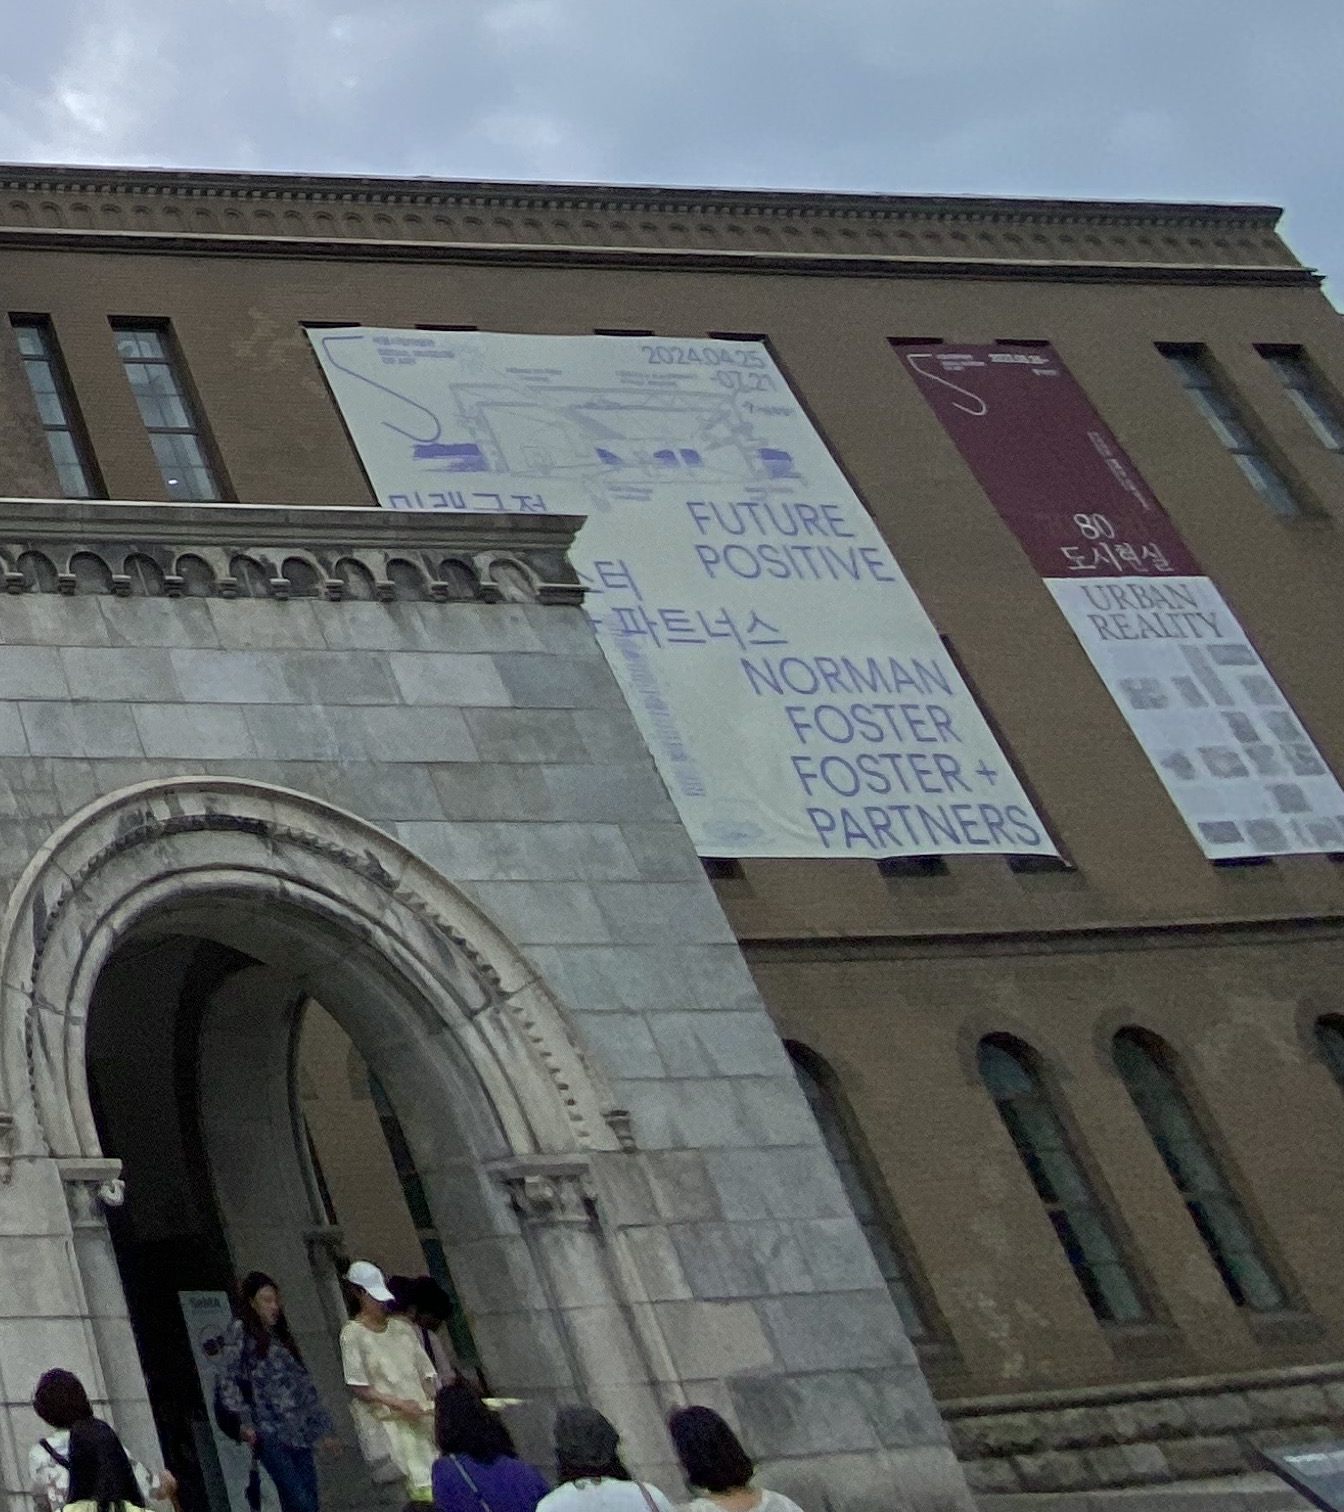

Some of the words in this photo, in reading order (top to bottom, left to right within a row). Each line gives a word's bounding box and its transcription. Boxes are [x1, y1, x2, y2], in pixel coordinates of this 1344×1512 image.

[686, 501, 854, 537] FUTURE
[1073, 513, 1114, 539] 80
[694, 544, 895, 581] POSITIVE
[1080, 584, 1199, 611] URBAN
[611, 605, 788, 650] 파트너스
[1087, 612, 1224, 640] REALITY
[740, 656, 953, 695] NORMAN
[785, 703, 962, 743] FOSTER
[790, 753, 973, 797] FOSTER
[976, 759, 997, 786] +
[806, 804, 1041, 849] PARTNERS
